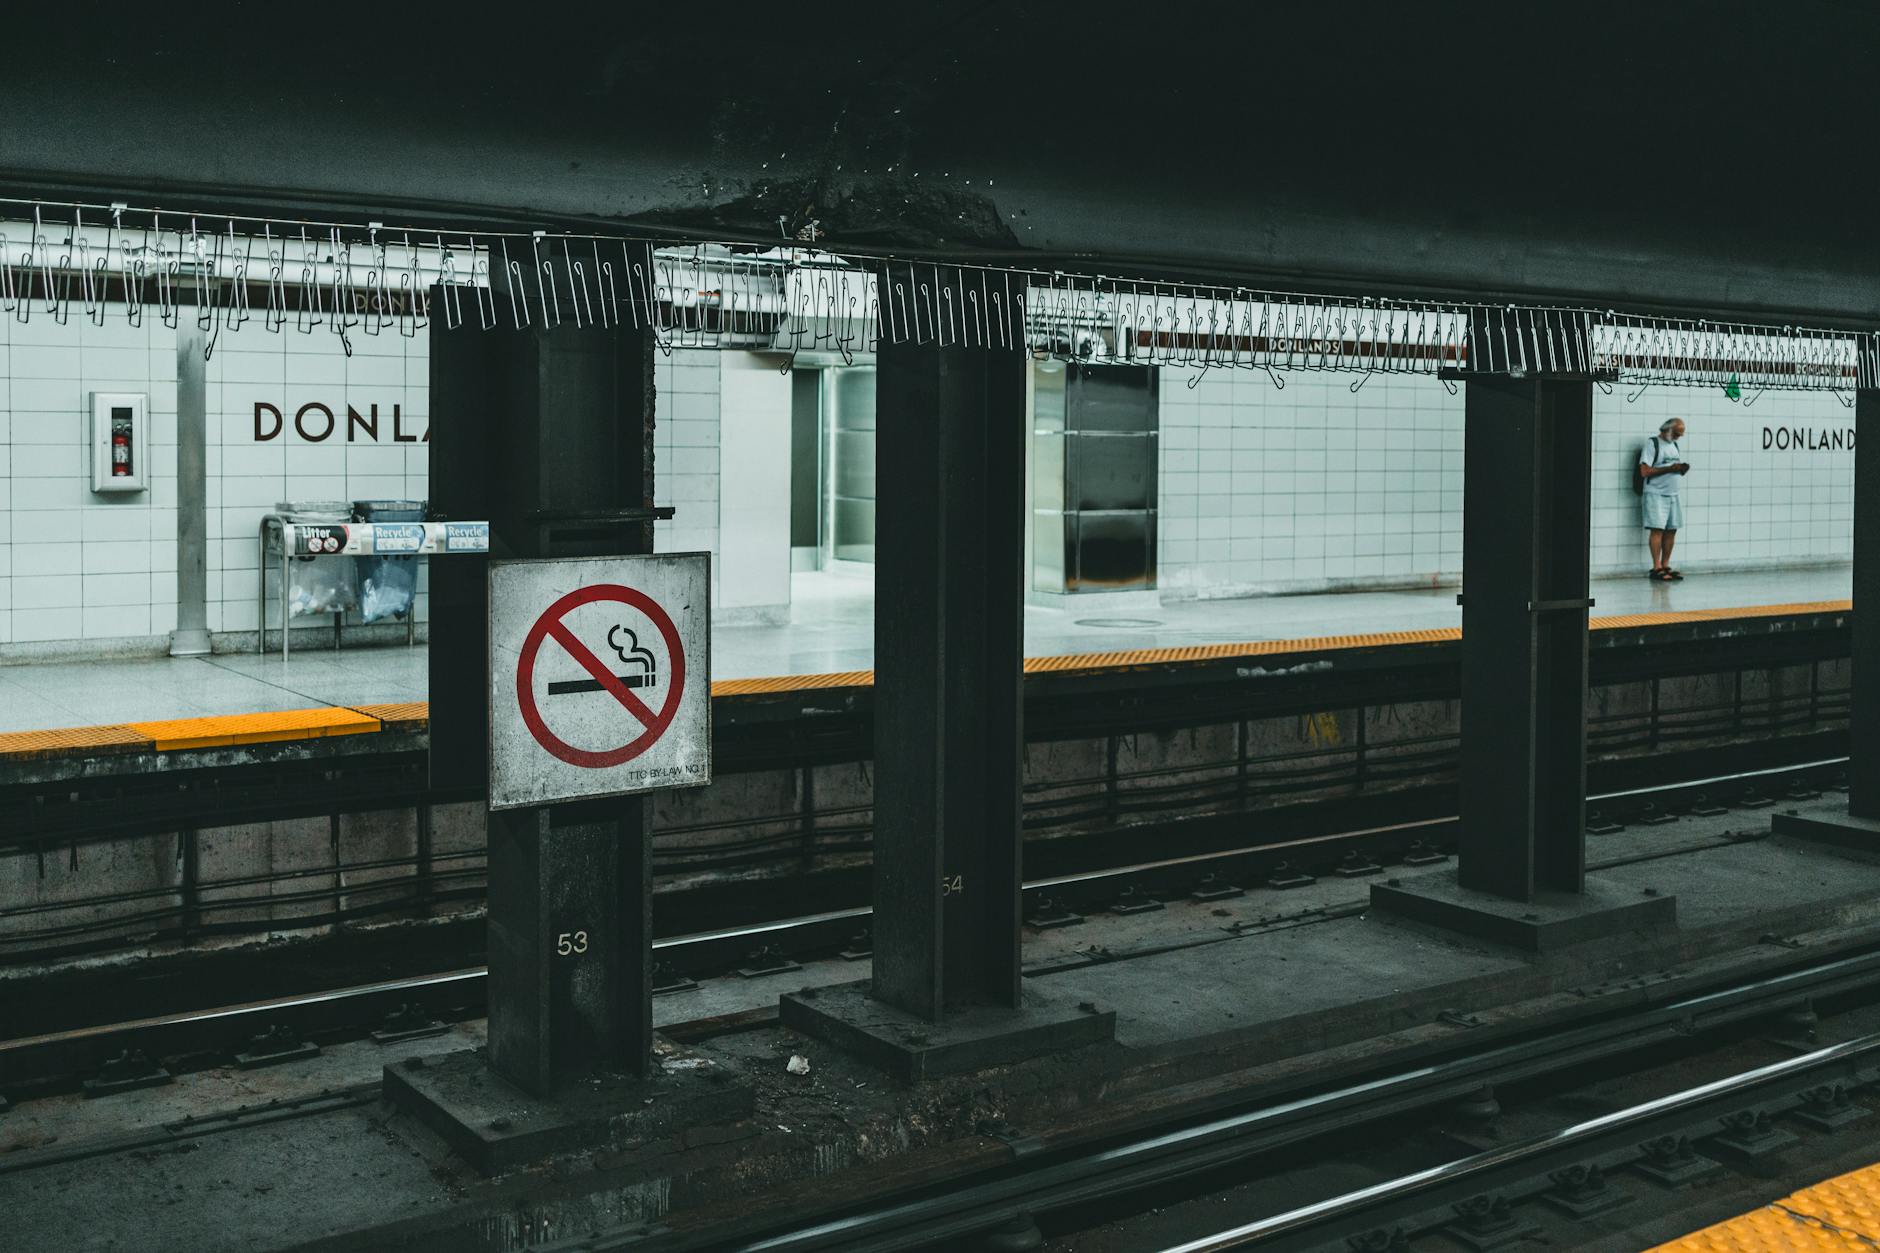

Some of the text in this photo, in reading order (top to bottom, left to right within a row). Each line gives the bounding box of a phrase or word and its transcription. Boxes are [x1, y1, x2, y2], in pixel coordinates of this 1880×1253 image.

[254, 402, 430, 442] DONL
[1762, 426, 1856, 450] DONLAND
[302, 526, 331, 539] Litter
[375, 526, 411, 539] Recycle
[447, 525, 482, 538] Recycle
[628, 770, 647, 780] TTC
[557, 931, 588, 956] 53
